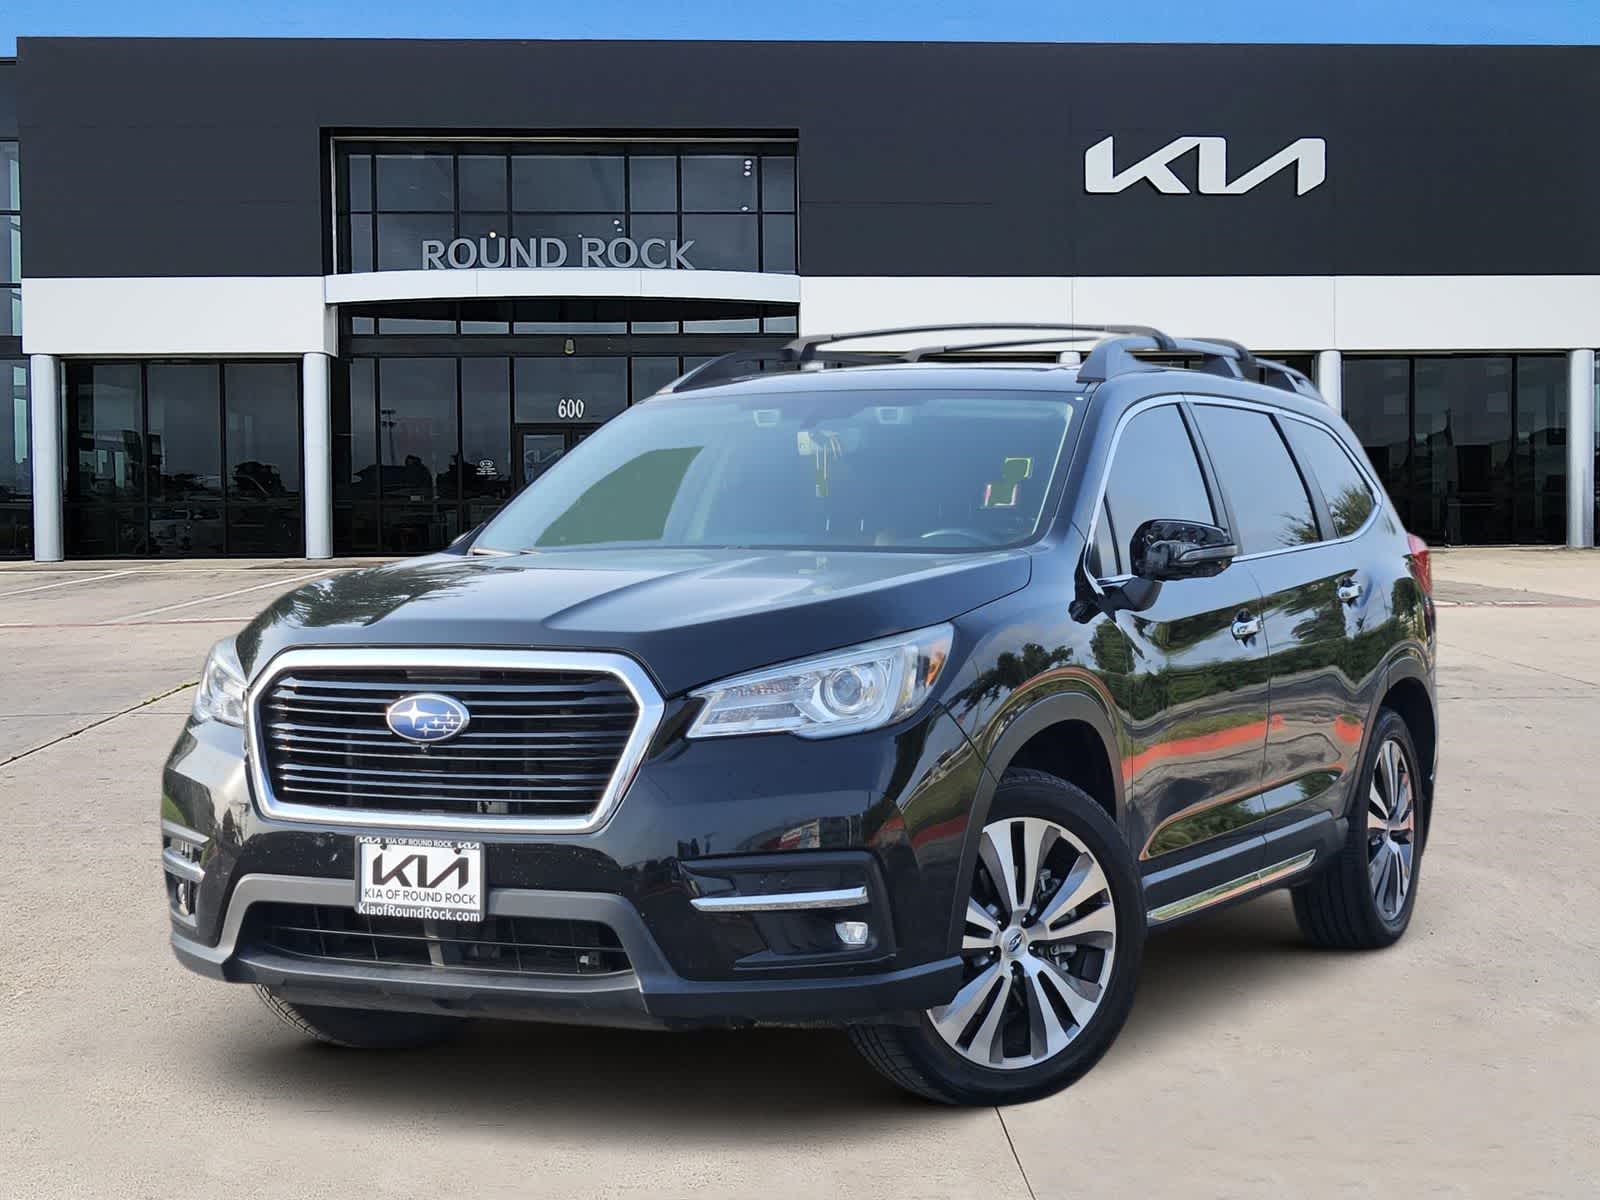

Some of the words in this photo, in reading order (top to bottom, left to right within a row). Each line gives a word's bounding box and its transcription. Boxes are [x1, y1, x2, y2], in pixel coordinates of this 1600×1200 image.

[1085, 135, 1326, 196] KIA
[422, 237, 568, 269] ROUND
[581, 237, 695, 269] ROCK
[558, 399, 585, 418] 600
[408, 838, 432, 848] ROUND
[433, 840, 453, 848] ROCK
[372, 852, 469, 889] KIA
[364, 887, 383, 899] KIA
[385, 889, 401, 900] OF
[402, 890, 443, 903] ROUND
[445, 892, 476, 905] ROCK
[358, 902, 480, 922] KiaofRoundRock.com
